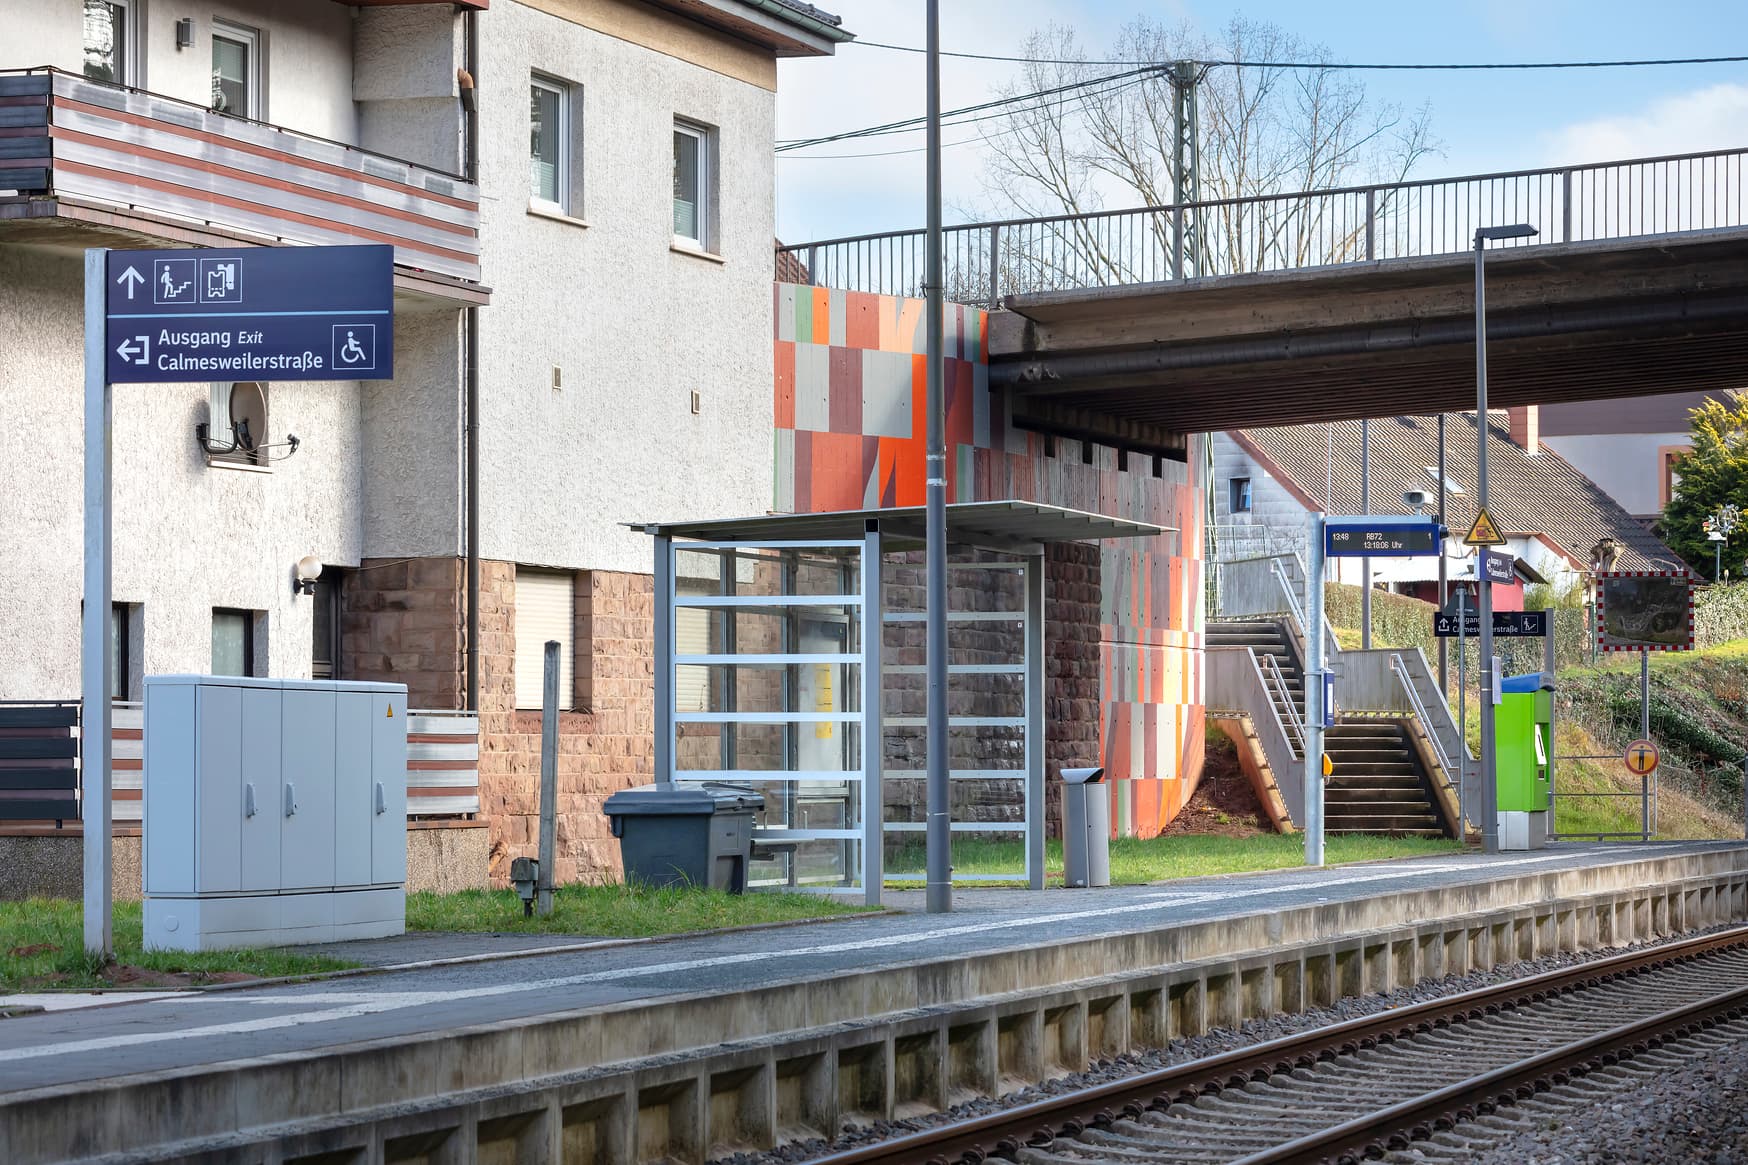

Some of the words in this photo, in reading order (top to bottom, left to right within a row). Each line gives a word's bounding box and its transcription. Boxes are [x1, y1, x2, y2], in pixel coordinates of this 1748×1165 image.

[158, 328, 231, 349] Ausgang
[238, 330, 264, 345] Exit
[157, 350, 324, 374] Calmesweilerstraße
[1366, 532, 1383, 541] RB72
[1391, 541, 1403, 549] Uhr
